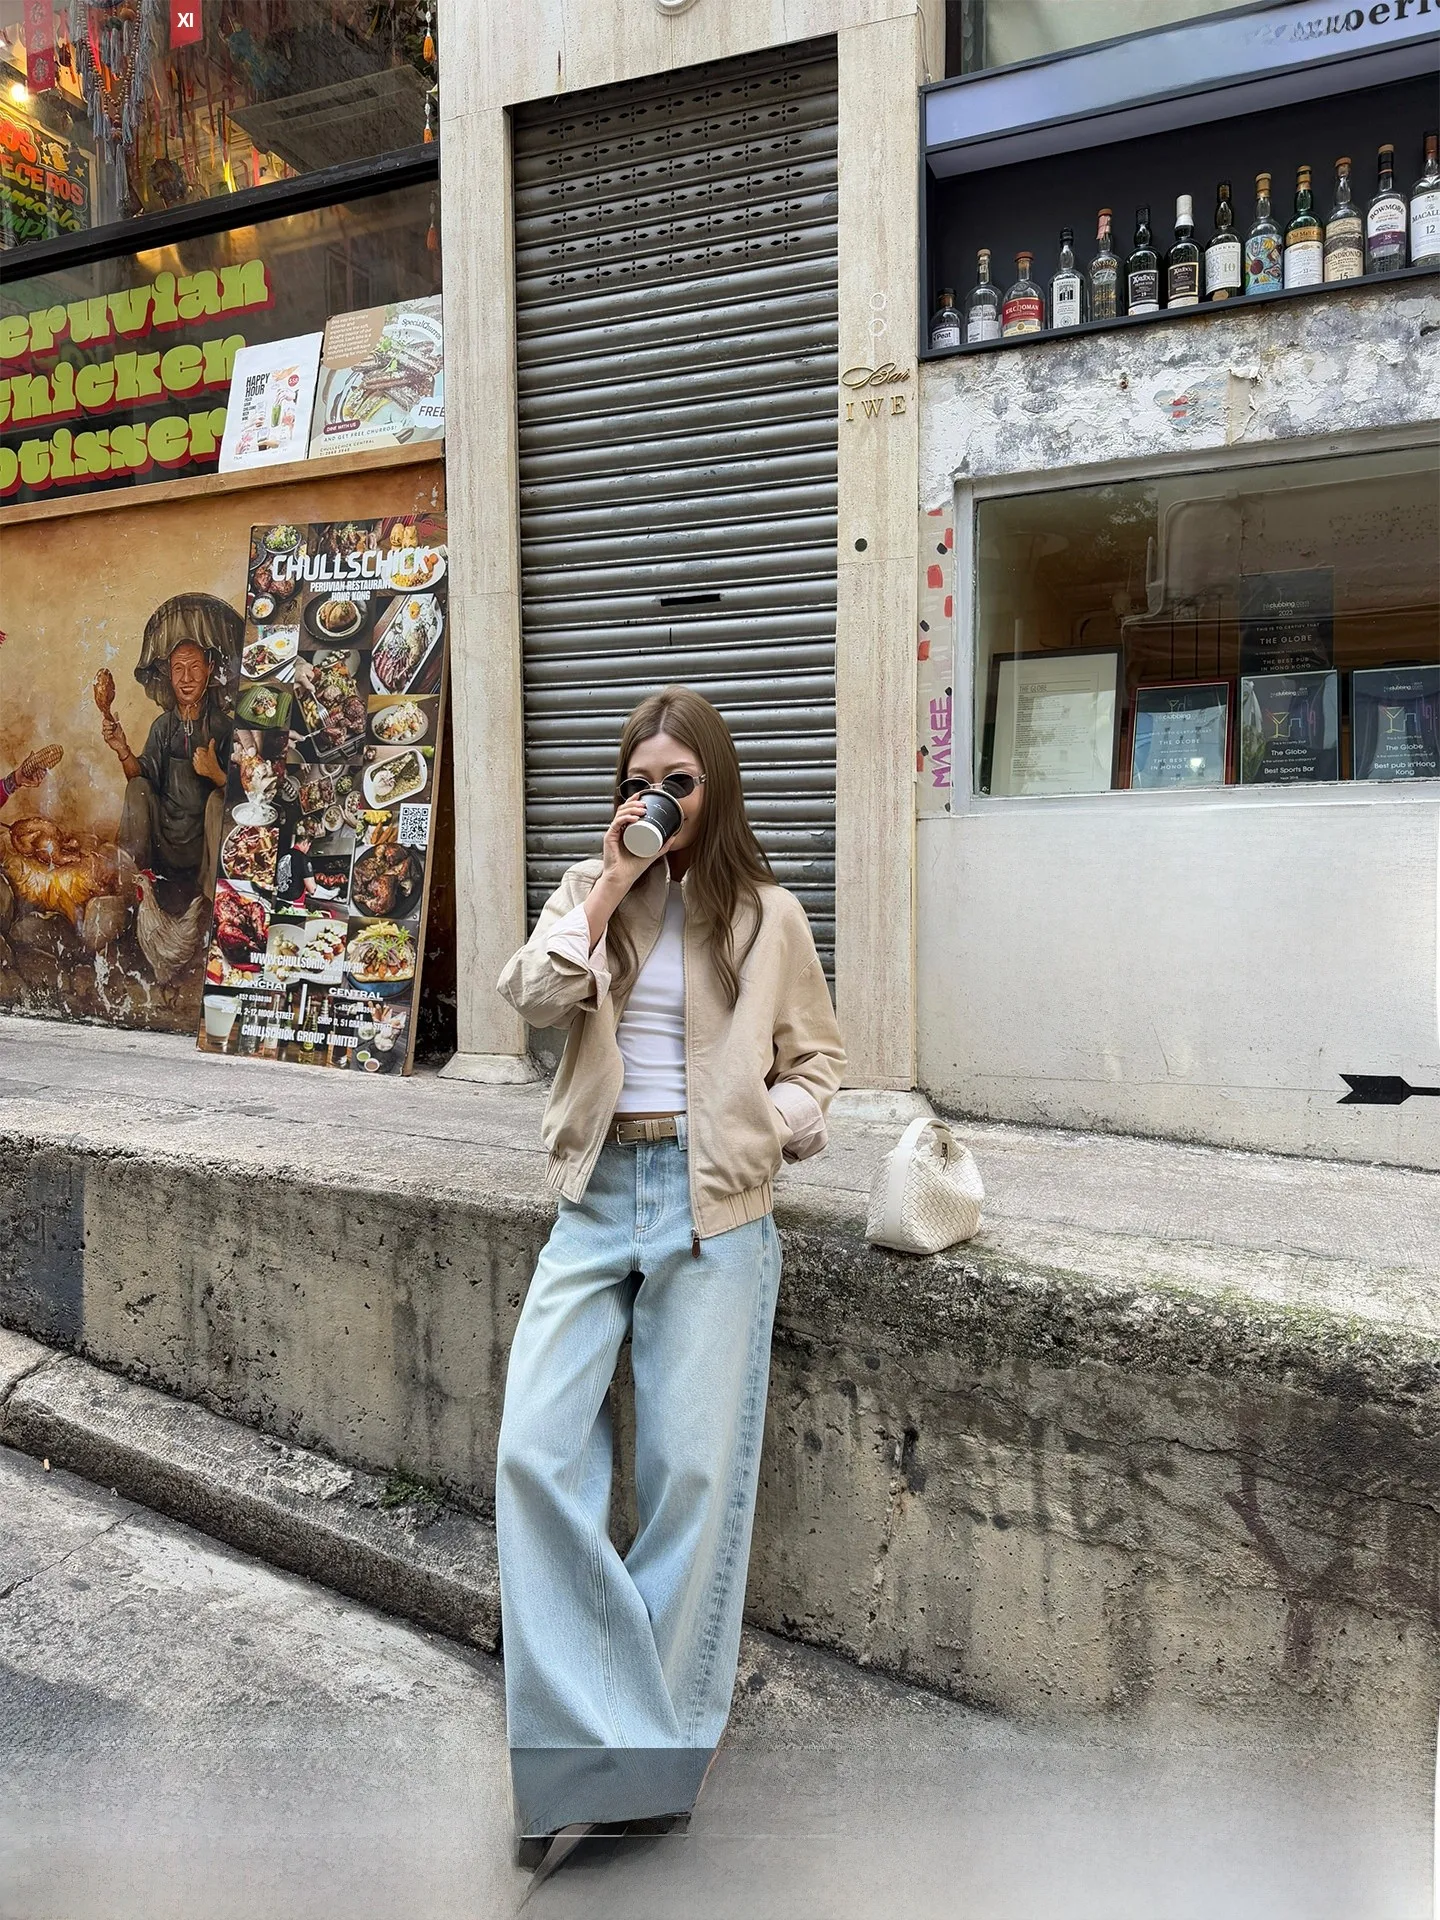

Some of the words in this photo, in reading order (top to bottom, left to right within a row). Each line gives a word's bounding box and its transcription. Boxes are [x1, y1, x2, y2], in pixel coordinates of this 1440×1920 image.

[1370, 203, 1405, 220] BOWMORE
[1426, 224, 1436, 234] 12
[0, 334, 247, 432] hicken
[246, 372, 270, 388] HAPPY
[245, 384, 266, 398] HOUR
[272, 545, 431, 582] CHULLSCHICK
[310, 580, 346, 592] PERUVIAN
[346, 578, 392, 590] RESTAURANT
[332, 591, 350, 601] HONG
[352, 590, 370, 600] KONG
[1280, 634, 1312, 643] GLOBE
[1280, 766, 1302, 774] Sports
[1390, 762, 1406, 770] pub
[1416, 760, 1436, 768] Hong
[328, 987, 384, 1002] CENTRAL
[244, 1008, 258, 1016] 2-12
[275, 1011, 294, 1020] STREET
[318, 1016, 332, 1025] SHOP
[296, 1030, 326, 1045] GROUP
[326, 1033, 358, 1048] LIMITED
